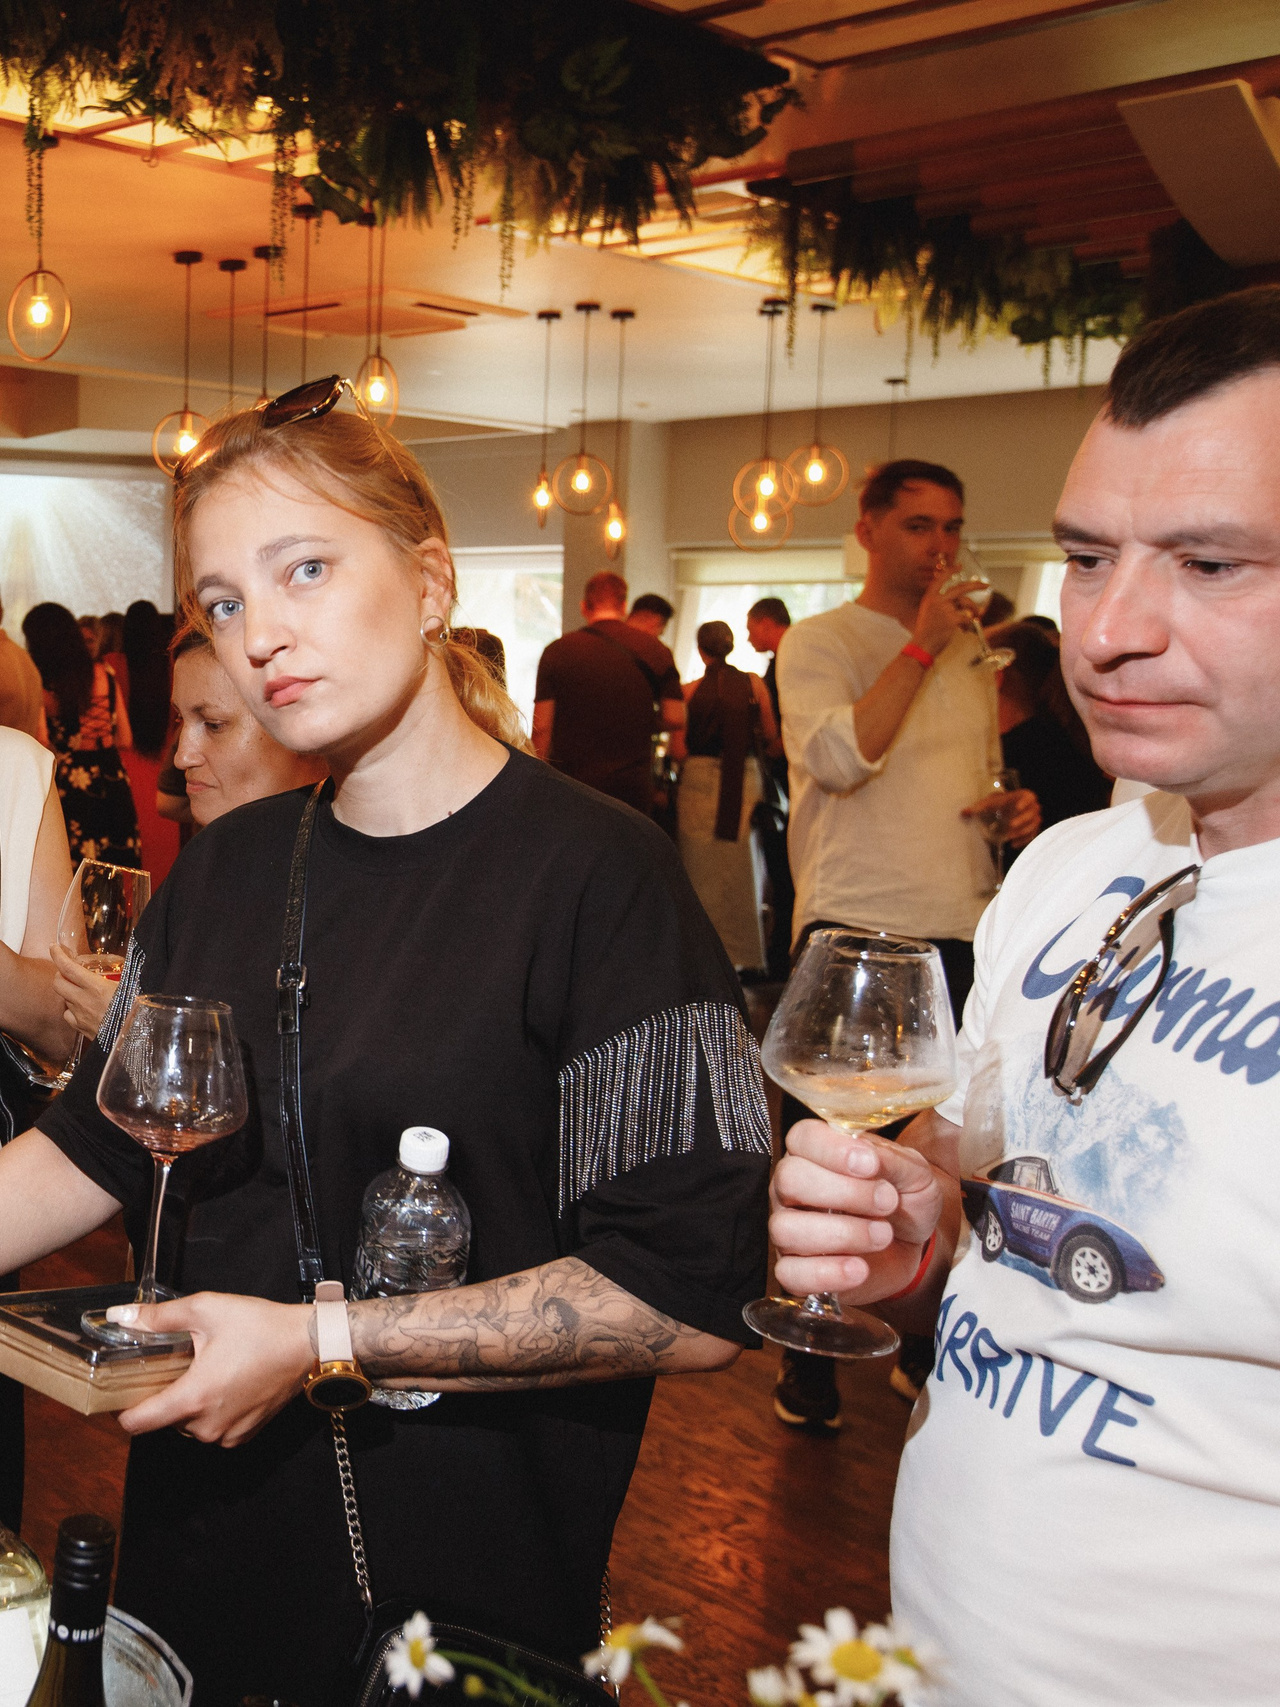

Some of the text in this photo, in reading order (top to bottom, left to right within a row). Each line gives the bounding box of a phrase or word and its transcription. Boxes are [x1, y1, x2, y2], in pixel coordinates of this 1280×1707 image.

[1011, 1201, 1062, 1232] SAINT BARTH
[1031, 1228, 1052, 1242] TEAM
[932, 1293, 1156, 1468] ARRIVE
